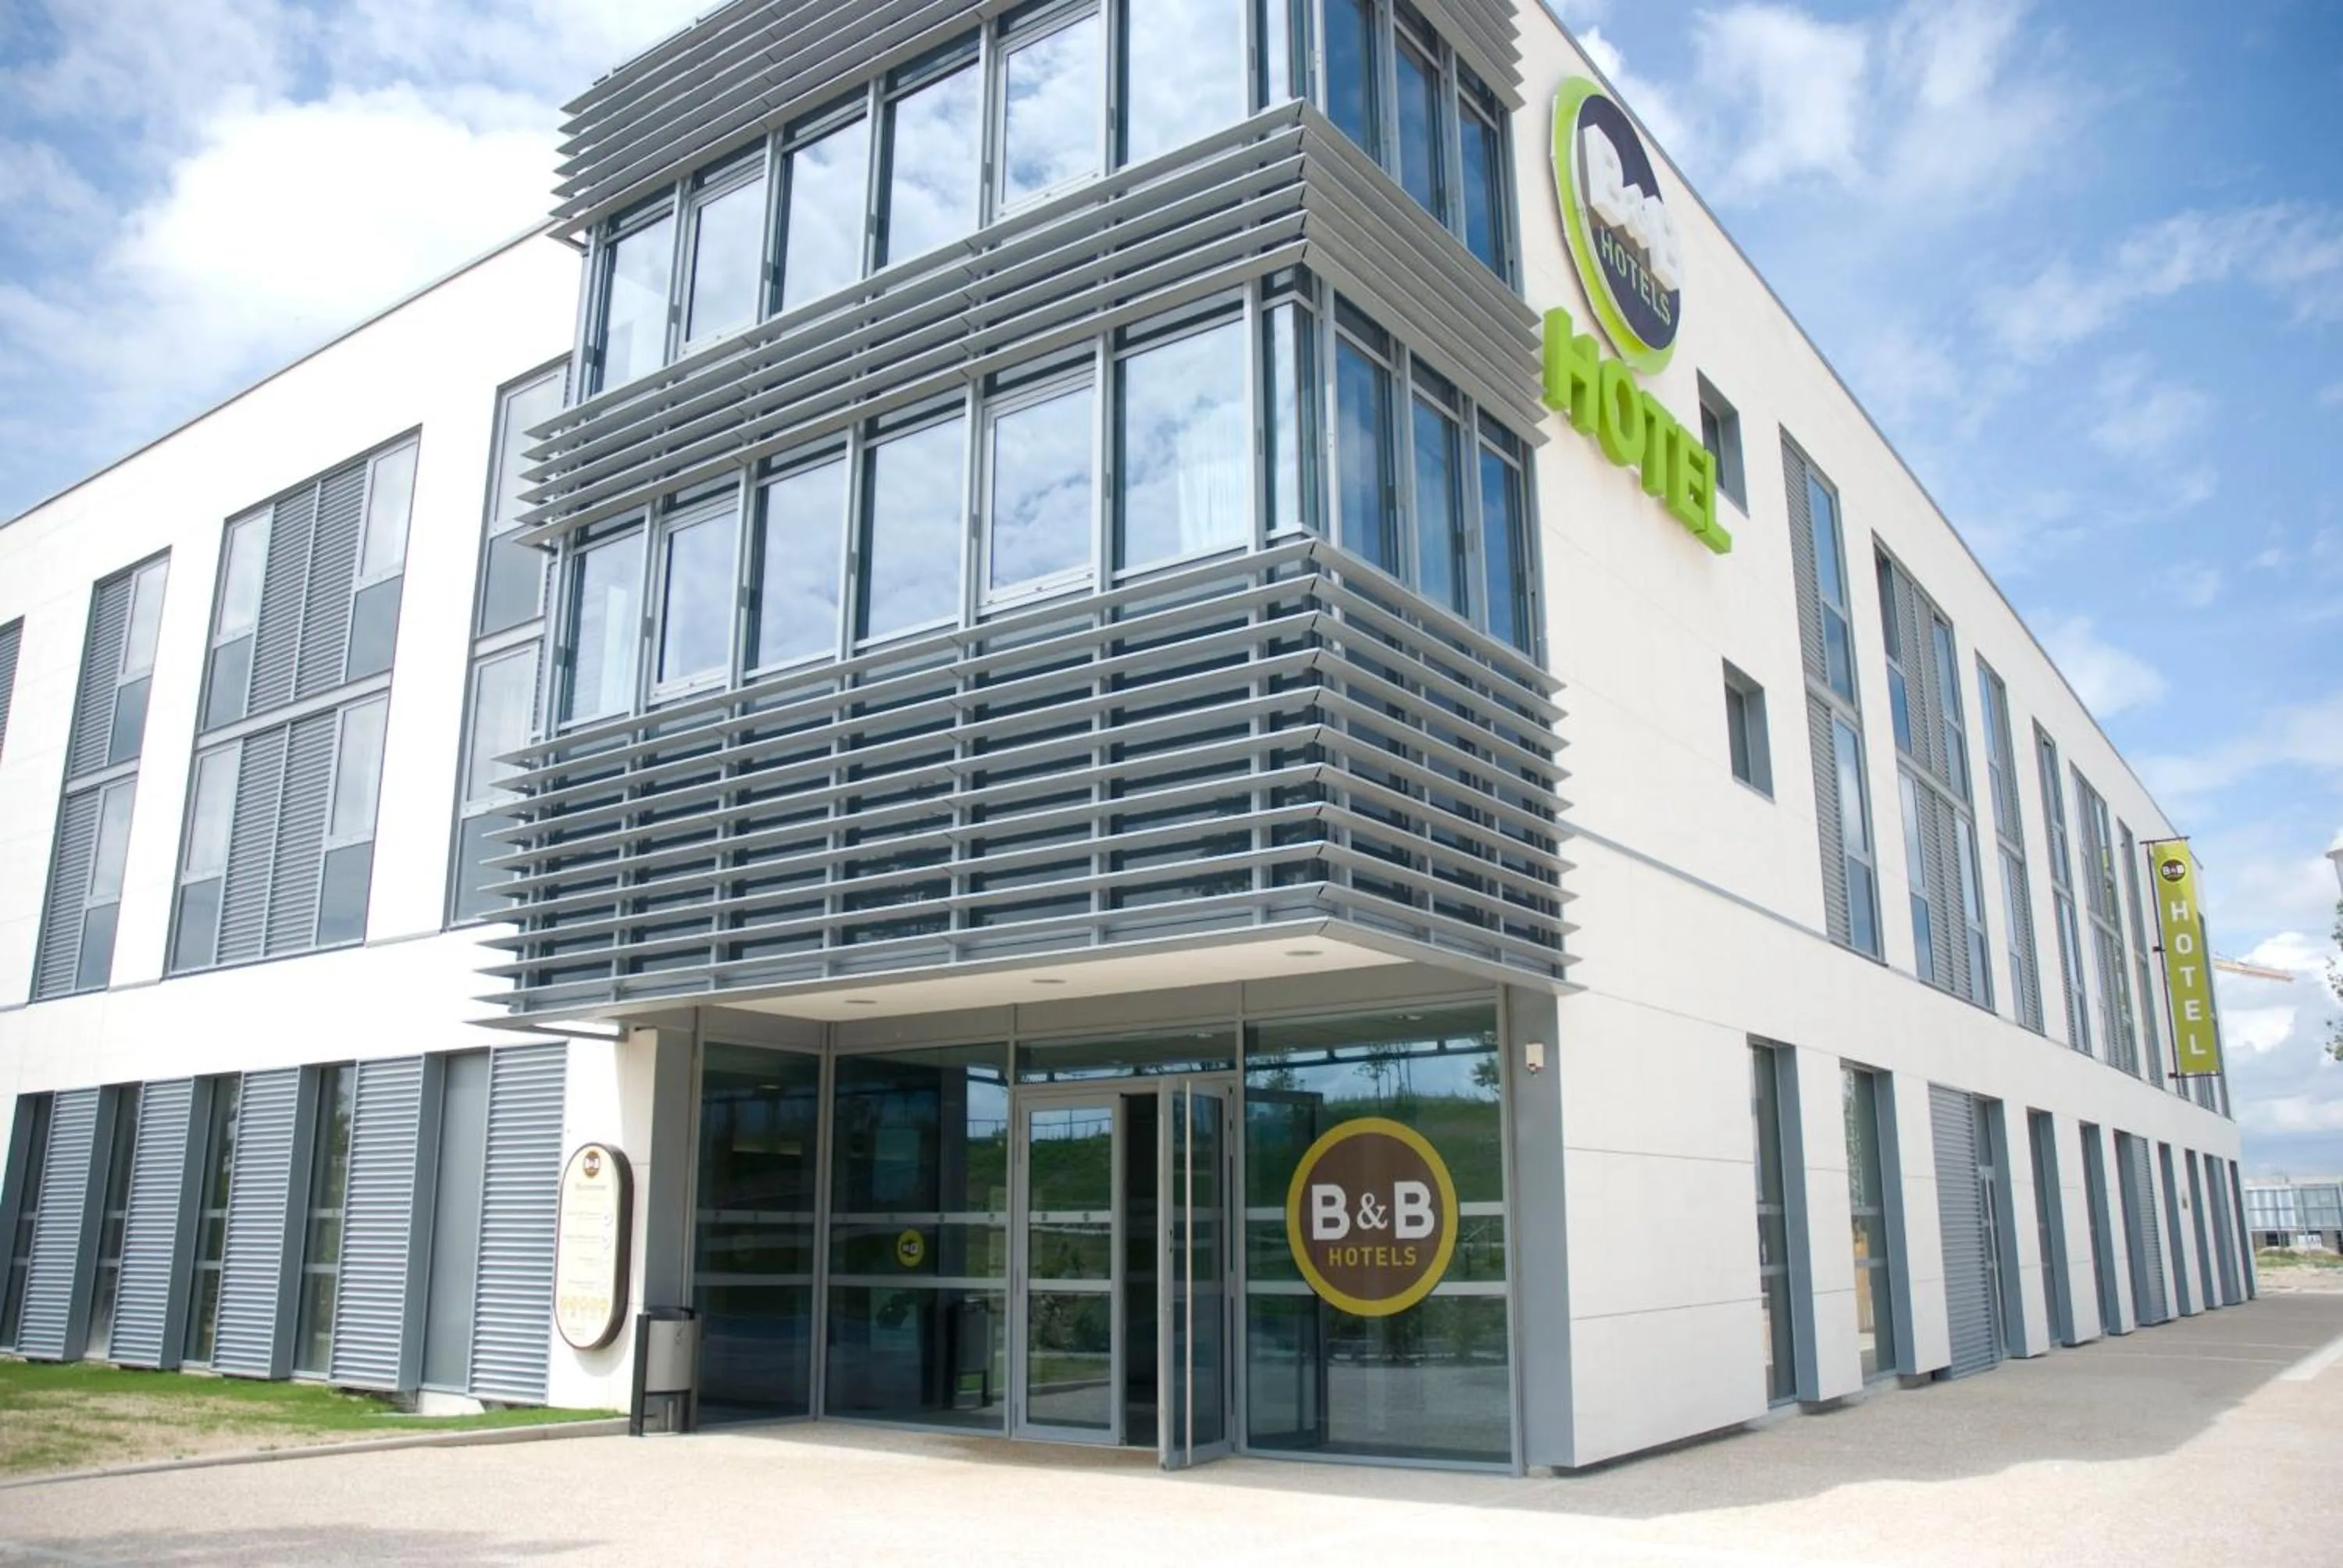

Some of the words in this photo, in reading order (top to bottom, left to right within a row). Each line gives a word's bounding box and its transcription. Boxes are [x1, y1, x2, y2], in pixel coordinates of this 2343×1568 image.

[1600, 225, 1671, 326] HOTELS
[1542, 306, 1731, 554] HOTEL
[2170, 900, 2207, 1055] HOTEL
[1311, 1181, 1435, 1241] B&B
[1328, 1247, 1417, 1267] HOTELS
